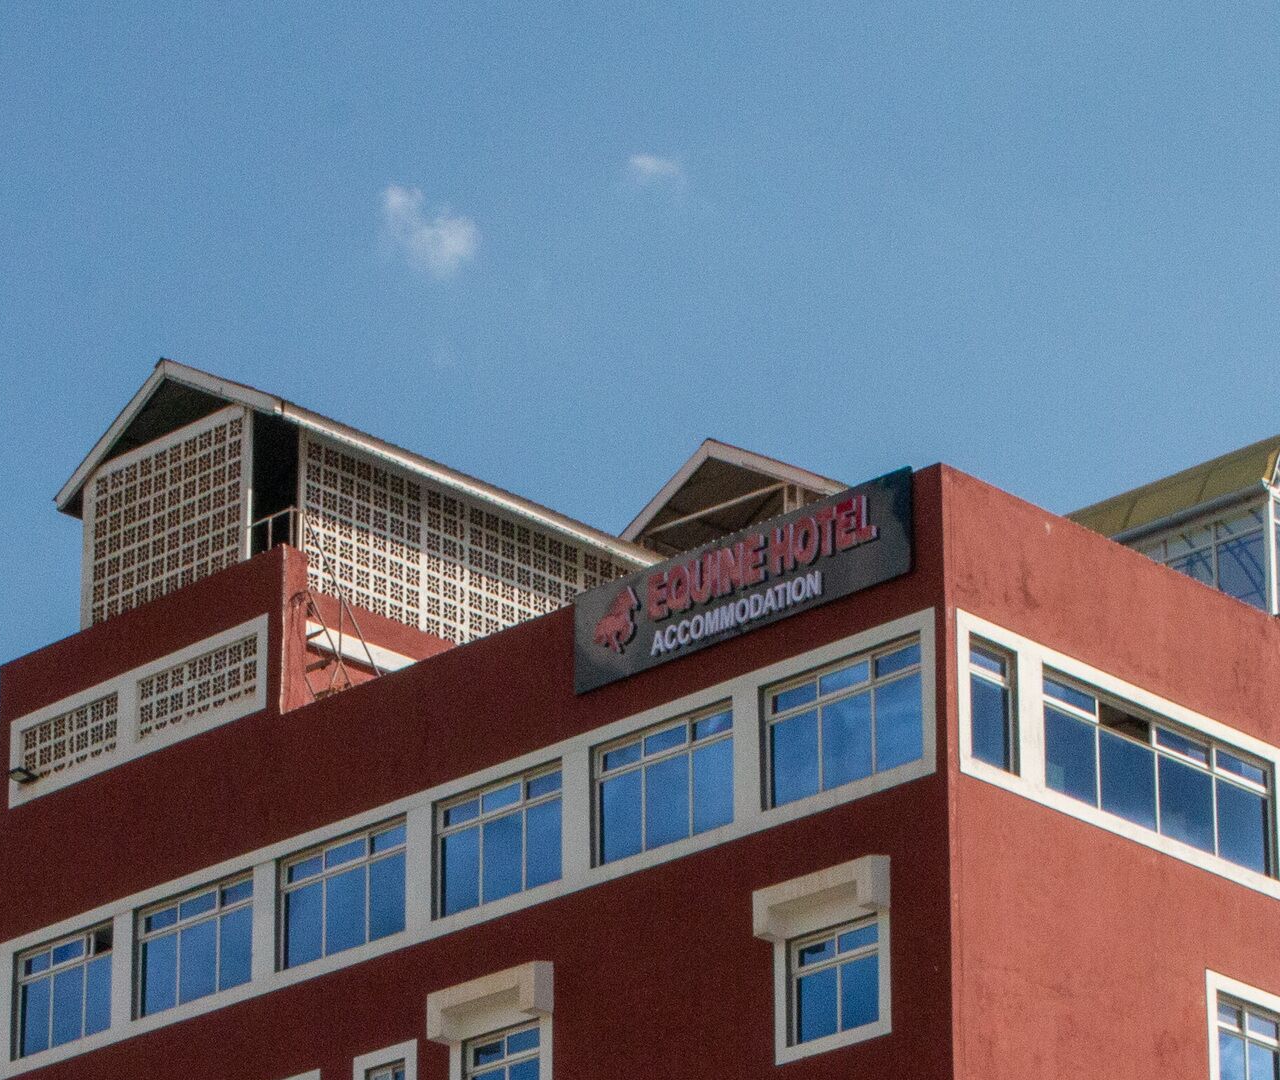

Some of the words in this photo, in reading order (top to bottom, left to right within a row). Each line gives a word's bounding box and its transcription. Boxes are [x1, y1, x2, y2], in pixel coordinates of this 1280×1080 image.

[646, 534, 767, 620] EQUINE
[770, 494, 877, 576] HOTEL
[650, 571, 822, 656] ACCOMMODATION
